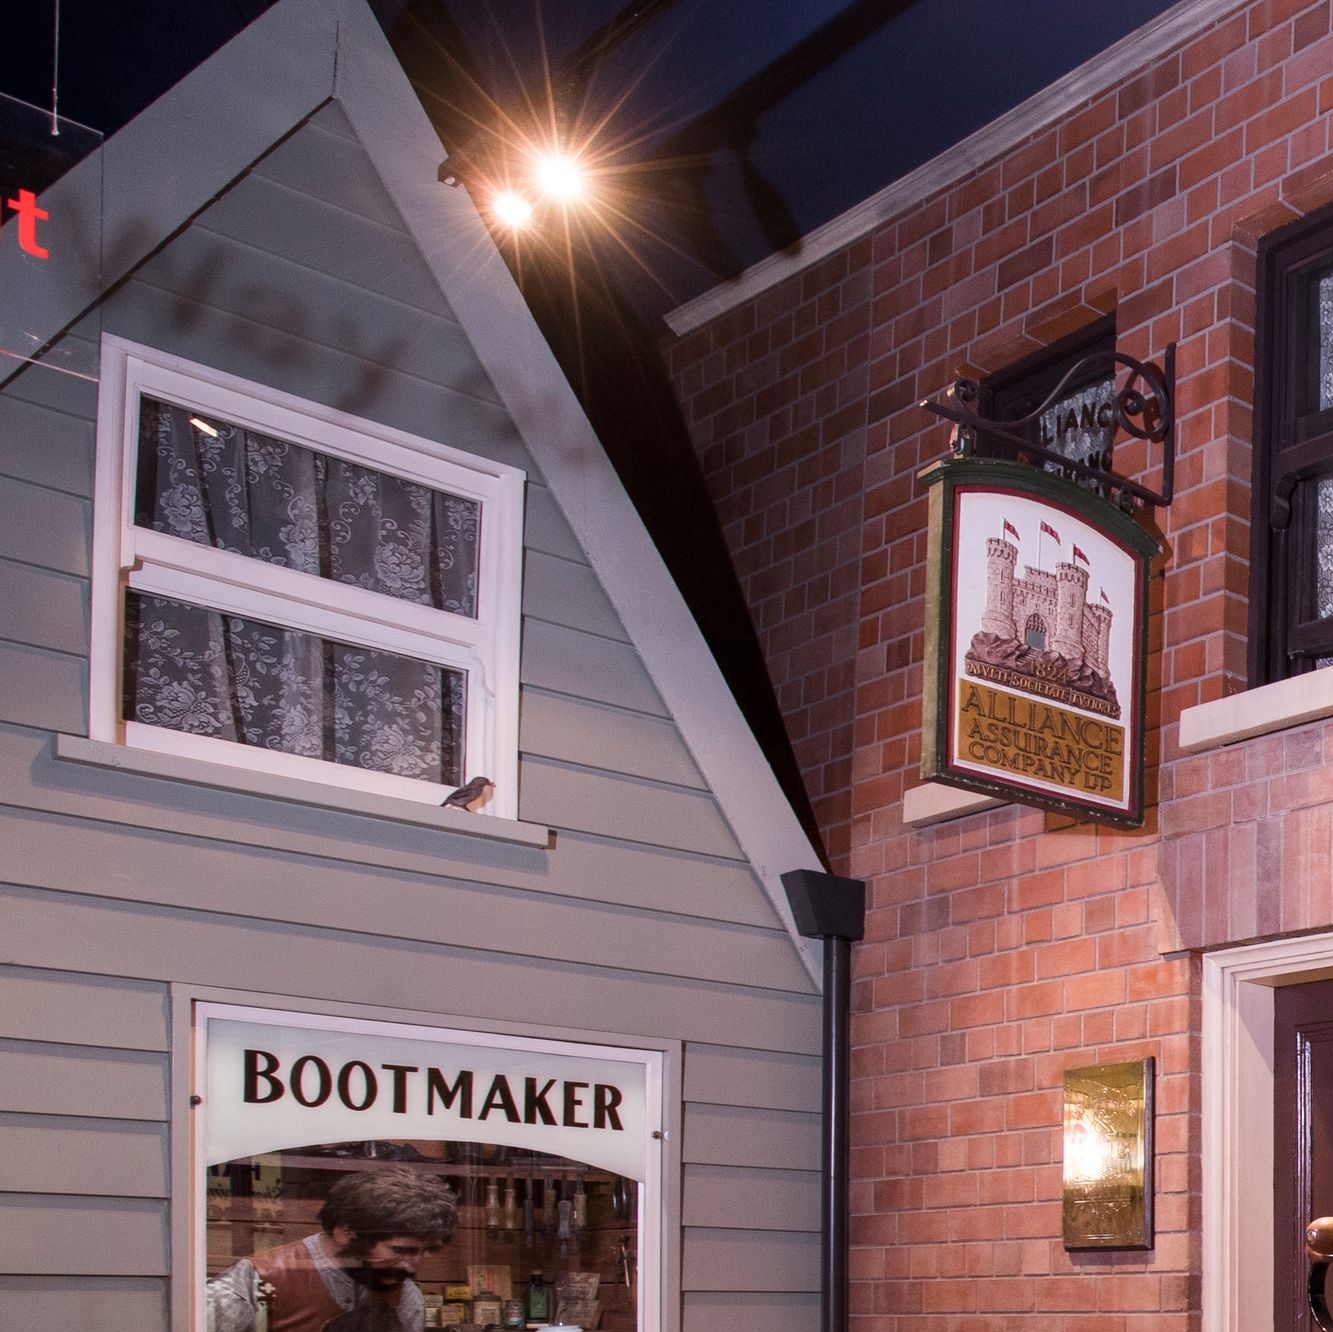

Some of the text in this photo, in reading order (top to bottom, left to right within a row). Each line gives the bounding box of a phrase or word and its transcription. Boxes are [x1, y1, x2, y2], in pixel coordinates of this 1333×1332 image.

[0, 188, 49, 259] t
[1030, 659, 1069, 683] 1824
[962, 685, 1122, 756] ALLIANCE
[968, 718, 1113, 775] ASSURANCE
[968, 742, 1080, 785] COMPANY
[242, 1047, 625, 1132] BOOTMAKER
